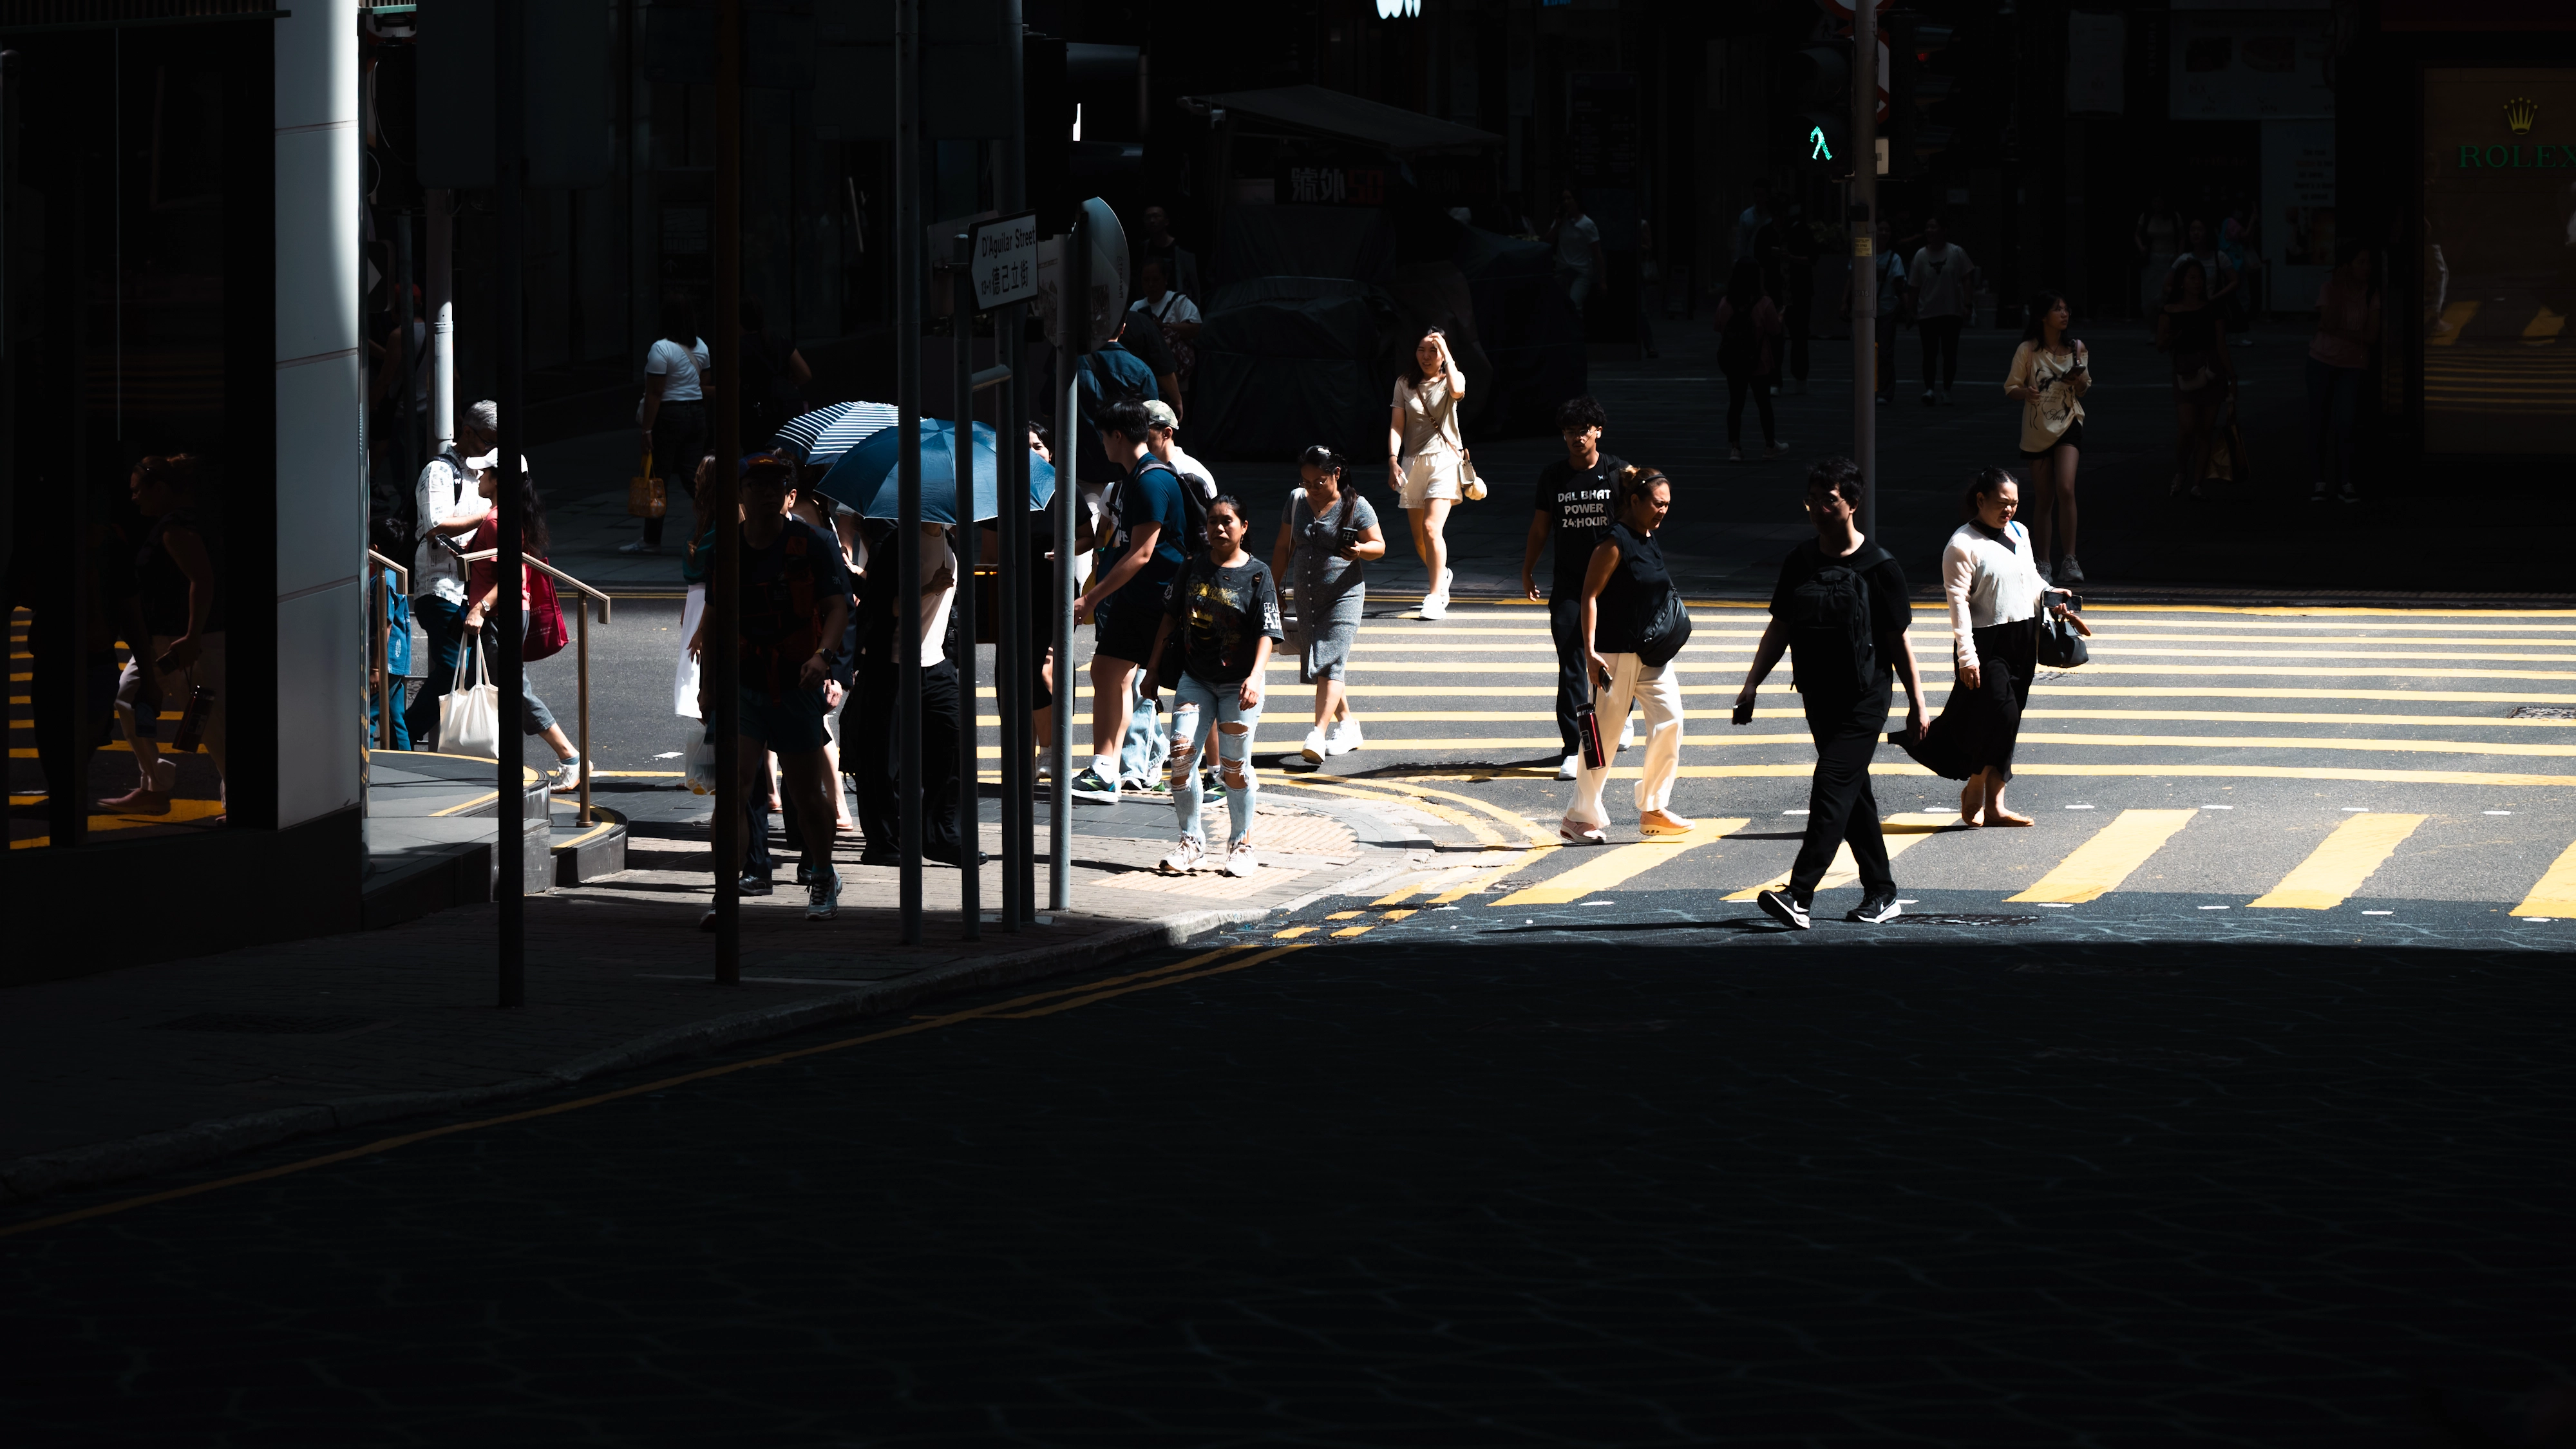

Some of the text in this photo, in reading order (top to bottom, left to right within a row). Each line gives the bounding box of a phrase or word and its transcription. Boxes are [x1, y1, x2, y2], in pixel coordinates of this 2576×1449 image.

[2458, 144, 2576, 168] ROLEX
[982, 225, 1036, 259] D'Aguilar Street
[992, 259, 1028, 296] 德己立街
[1557, 489, 1611, 503] DAL BHAT
[1564, 503, 1604, 515] POWER
